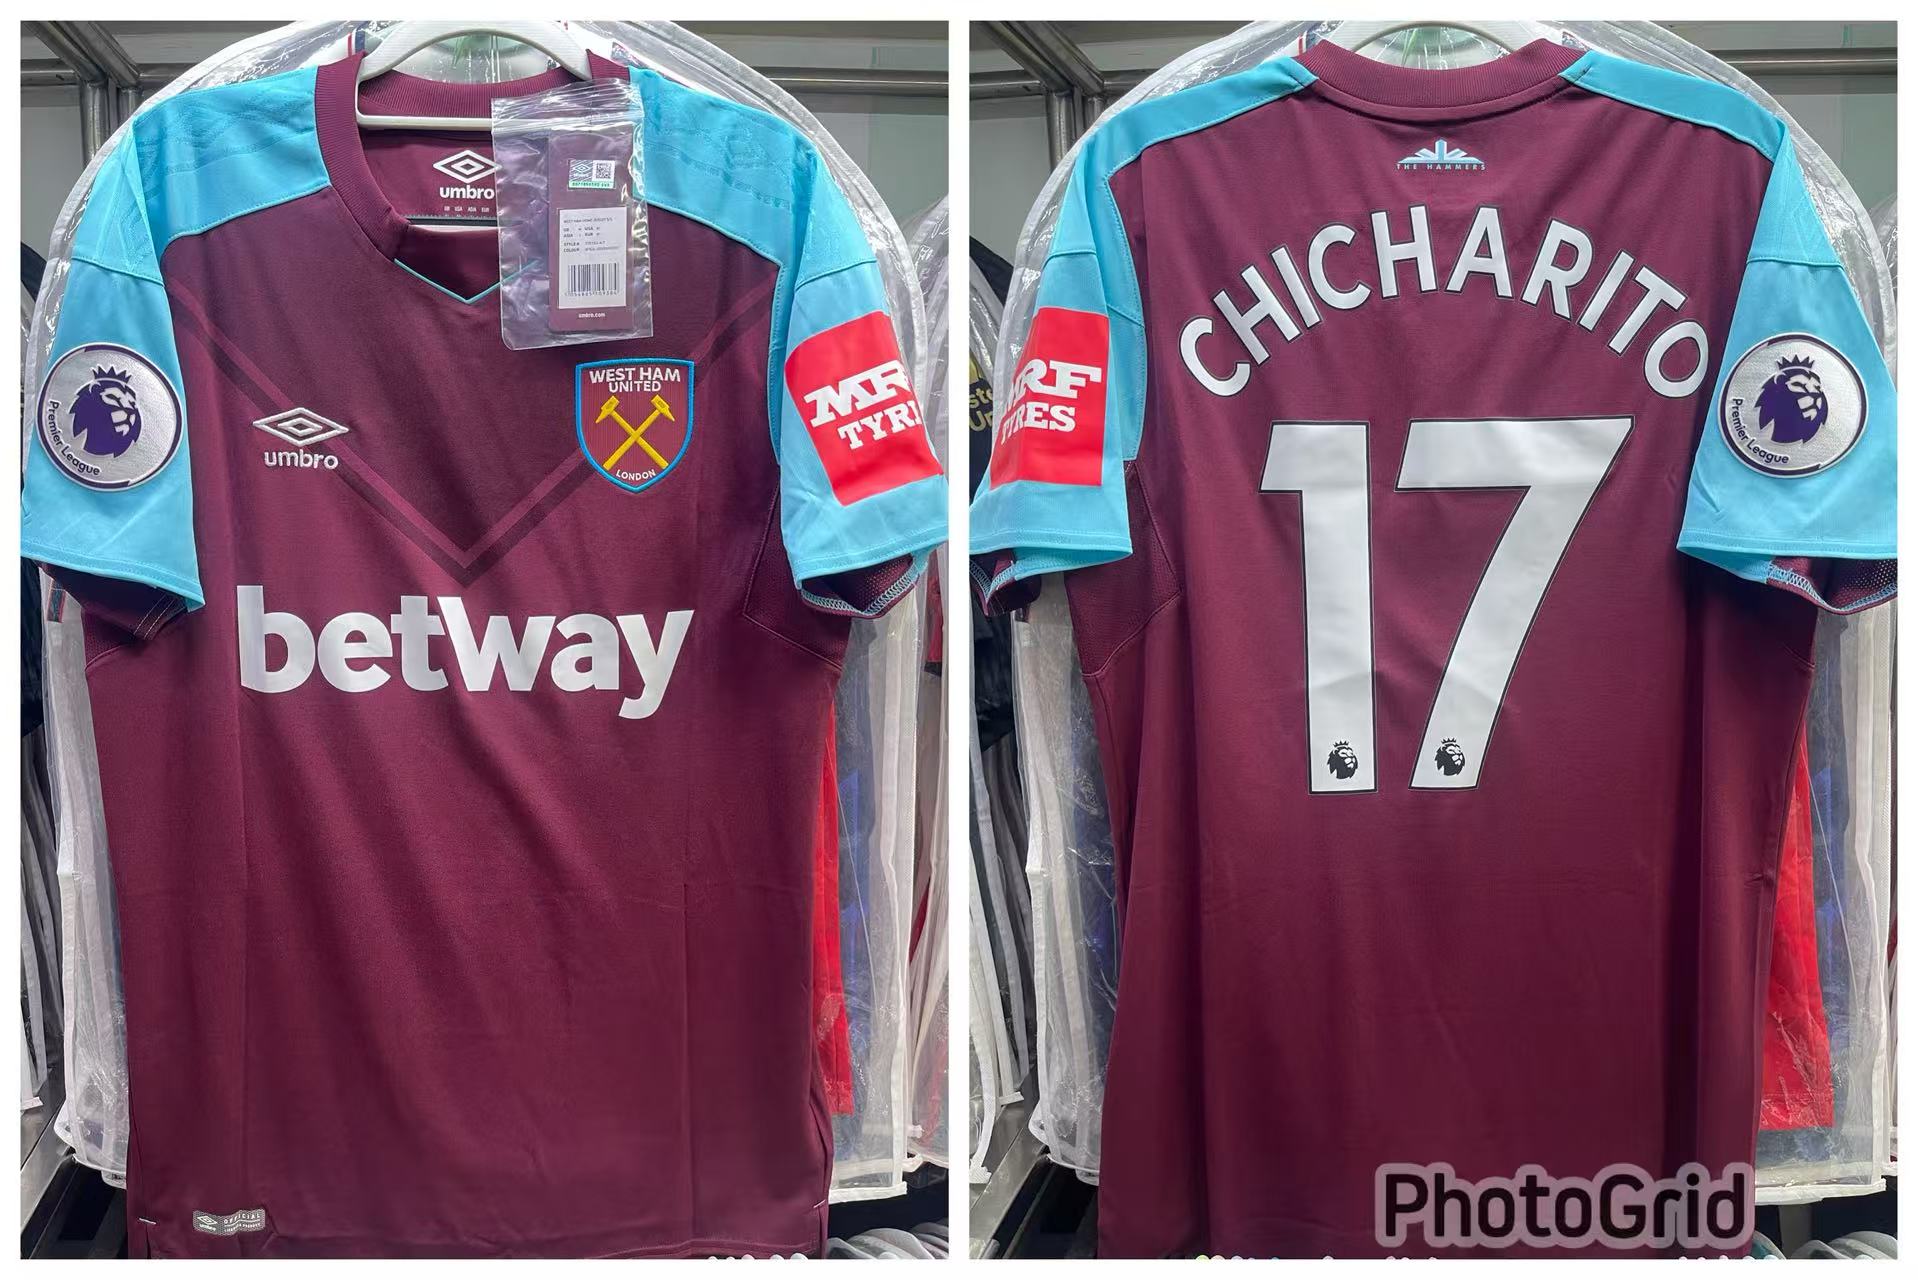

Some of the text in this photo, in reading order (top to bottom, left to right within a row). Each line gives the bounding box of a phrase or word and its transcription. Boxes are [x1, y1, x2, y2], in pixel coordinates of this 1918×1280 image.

[1427, 163, 1486, 171] HAMMERS
[439, 184, 495, 200] umbro
[1178, 203, 1710, 399] CHICHARITO
[589, 367, 681, 384] WEST HAM
[608, 380, 662, 393] UNITED
[803, 359, 912, 428] MR
[47, 400, 101, 476] Premier League
[837, 400, 923, 450] TYR
[1731, 398, 1789, 464] Premier League
[263, 448, 339, 470] umbro
[615, 468, 657, 481] LONDON
[1258, 415, 1635, 795] 17
[236, 585, 695, 720] betway
[223, 1213, 261, 1224] OFFICIAL
